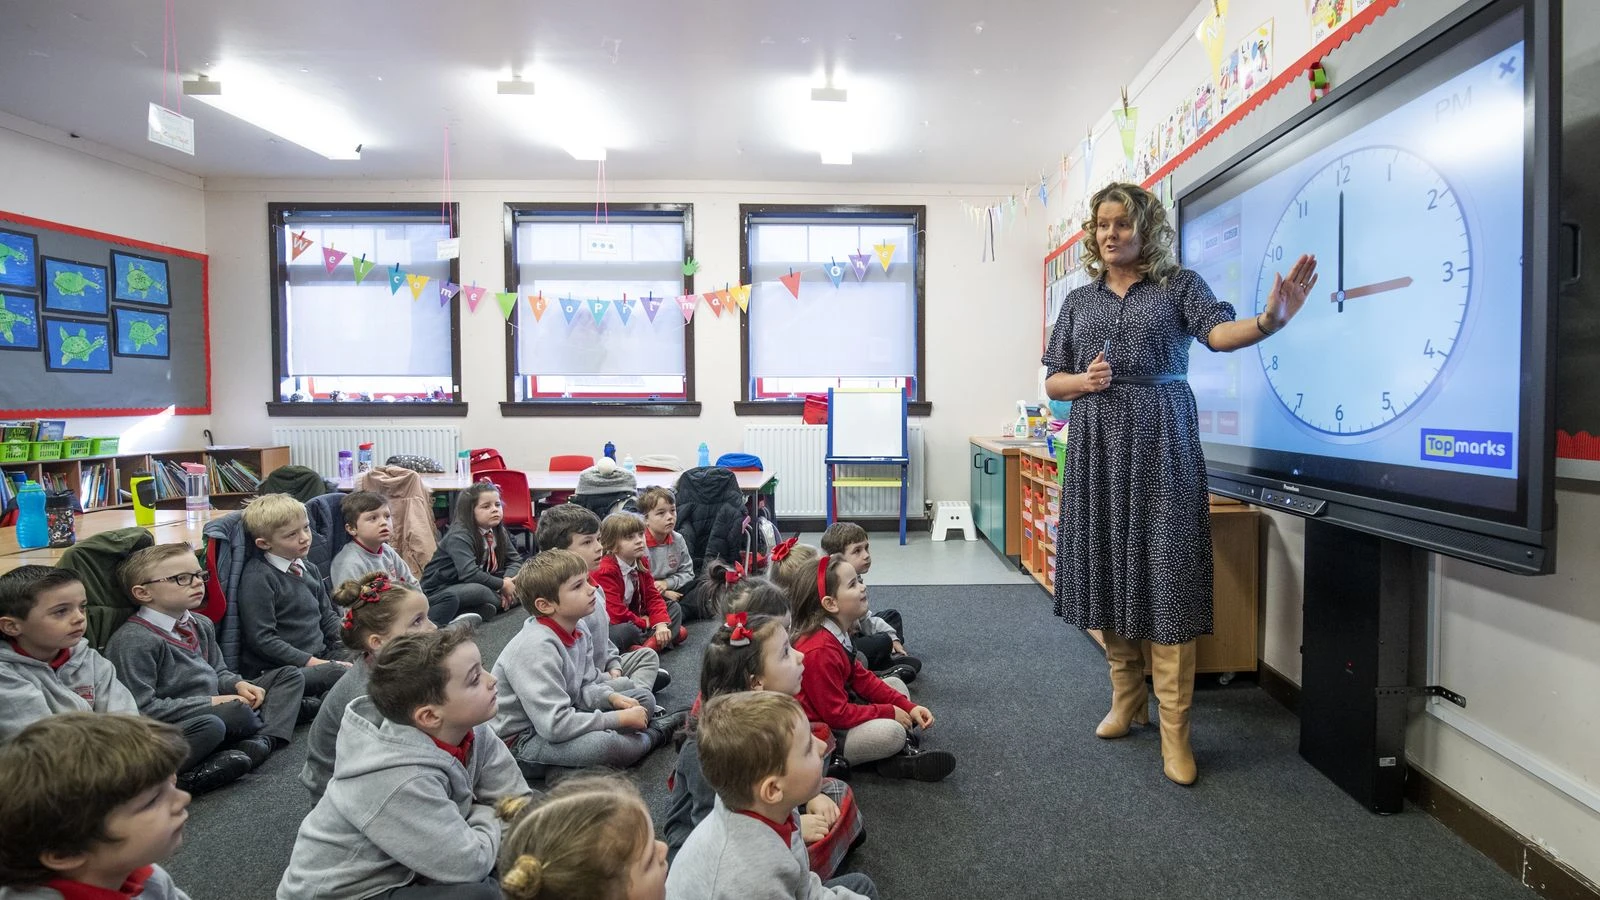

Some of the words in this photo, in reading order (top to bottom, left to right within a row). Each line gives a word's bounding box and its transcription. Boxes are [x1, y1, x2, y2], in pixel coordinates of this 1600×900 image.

[1435, 85, 1472, 123] PM
[1336, 165, 1350, 187] 12
[1387, 163, 1391, 182] 1
[1427, 188, 1438, 210] 2
[1299, 200, 1308, 218] 11
[1271, 245, 1283, 263] 10
[1442, 261, 1453, 282] 3
[1423, 339, 1435, 359] 4
[1272, 355, 1279, 370] 8
[1296, 393, 1304, 409] 7
[1382, 392, 1391, 410] 5
[1335, 404, 1344, 421] 6
[1427, 437, 1506, 457] Topmarks
